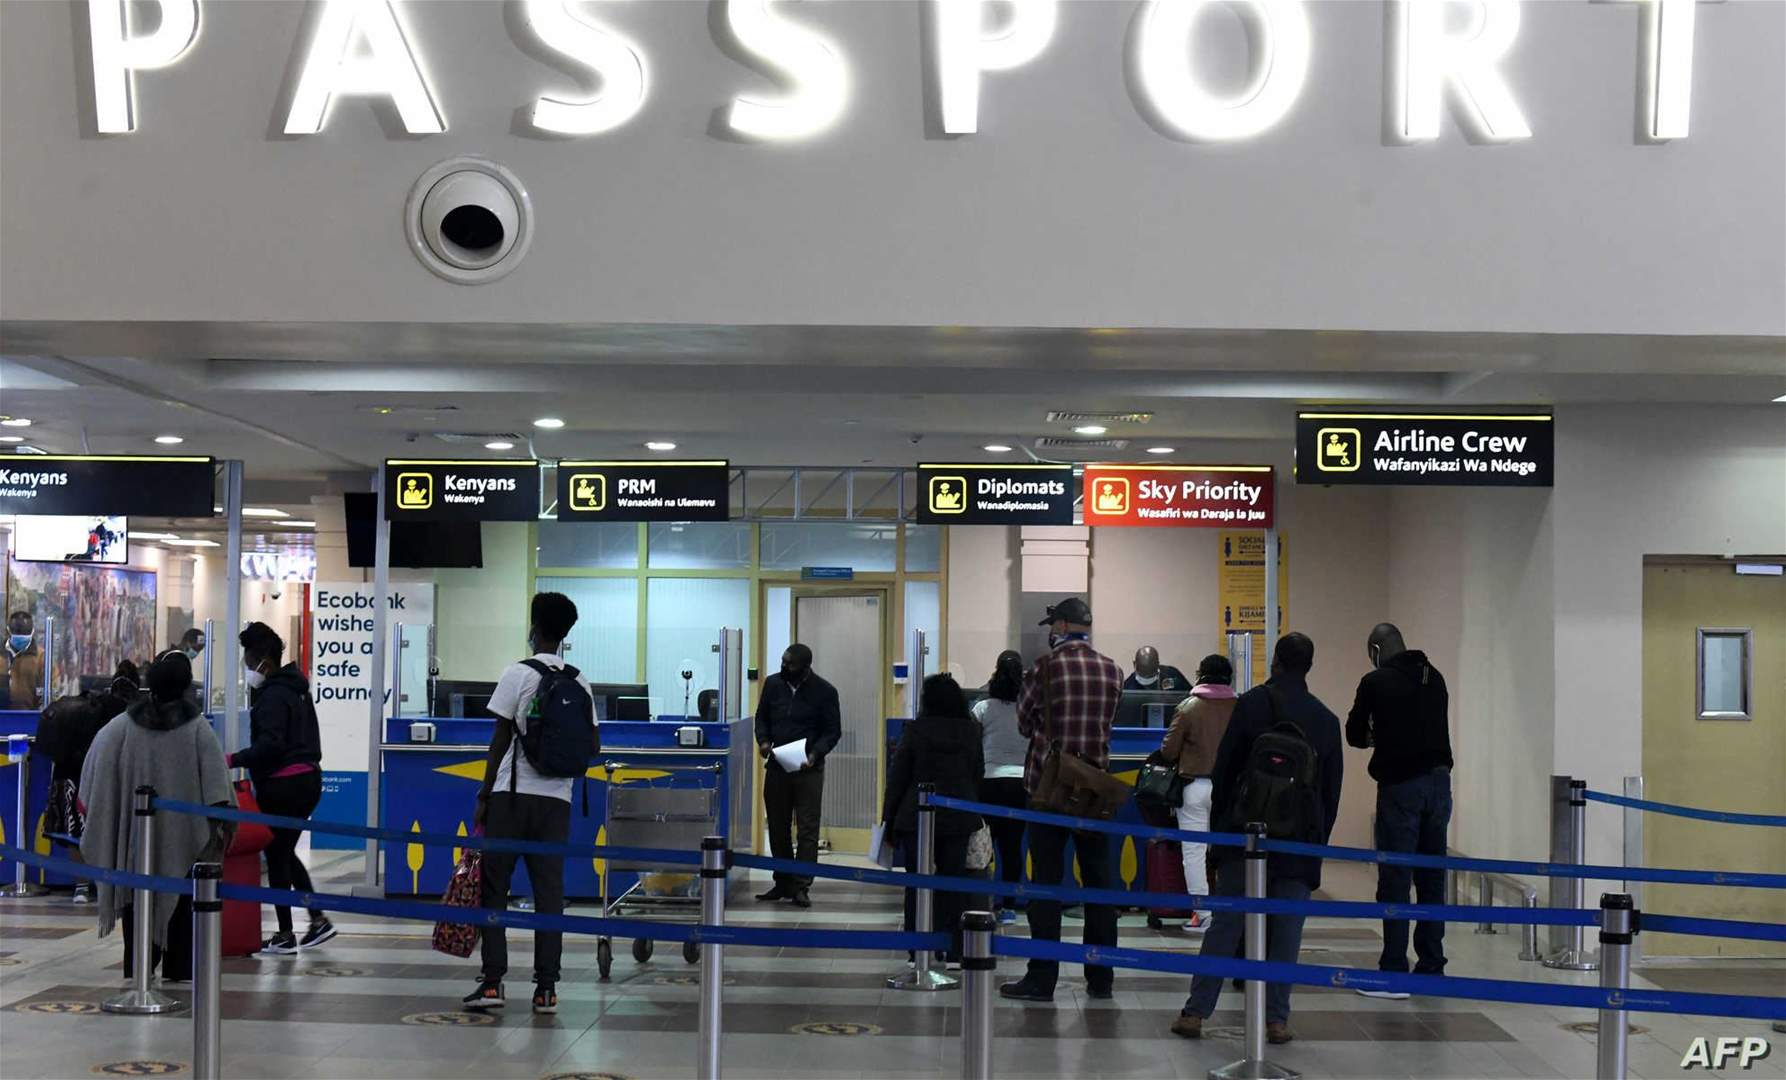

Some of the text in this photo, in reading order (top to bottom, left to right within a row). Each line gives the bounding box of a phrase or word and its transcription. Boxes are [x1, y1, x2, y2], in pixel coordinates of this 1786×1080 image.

[88, 0, 1725, 141] PASSPORT
[1373, 429, 1528, 452] Airline Crew
[1373, 458, 1537, 476] Wafanyikazi Wa Ndege
[0, 469, 67, 488] Kenyans
[444, 475, 516, 494] Kenyans
[618, 478, 656, 494] PRM
[977, 478, 1065, 498] Diplomats
[1137, 480, 1262, 505] Sky Priority
[444, 494, 485, 505] Wakenya
[664, 499, 676, 508] na
[677, 498, 716, 508] Ulemavu
[977, 501, 1049, 512] Wanadiplomasia
[1137, 508, 1180, 519] Wasafiri
[1182, 510, 1199, 519] wa
[1201, 509, 1235, 521] Daraja
[318, 614, 374, 631] wishe
[317, 640, 353, 657] you
[317, 660, 360, 677] safe
[315, 682, 392, 704] journy
